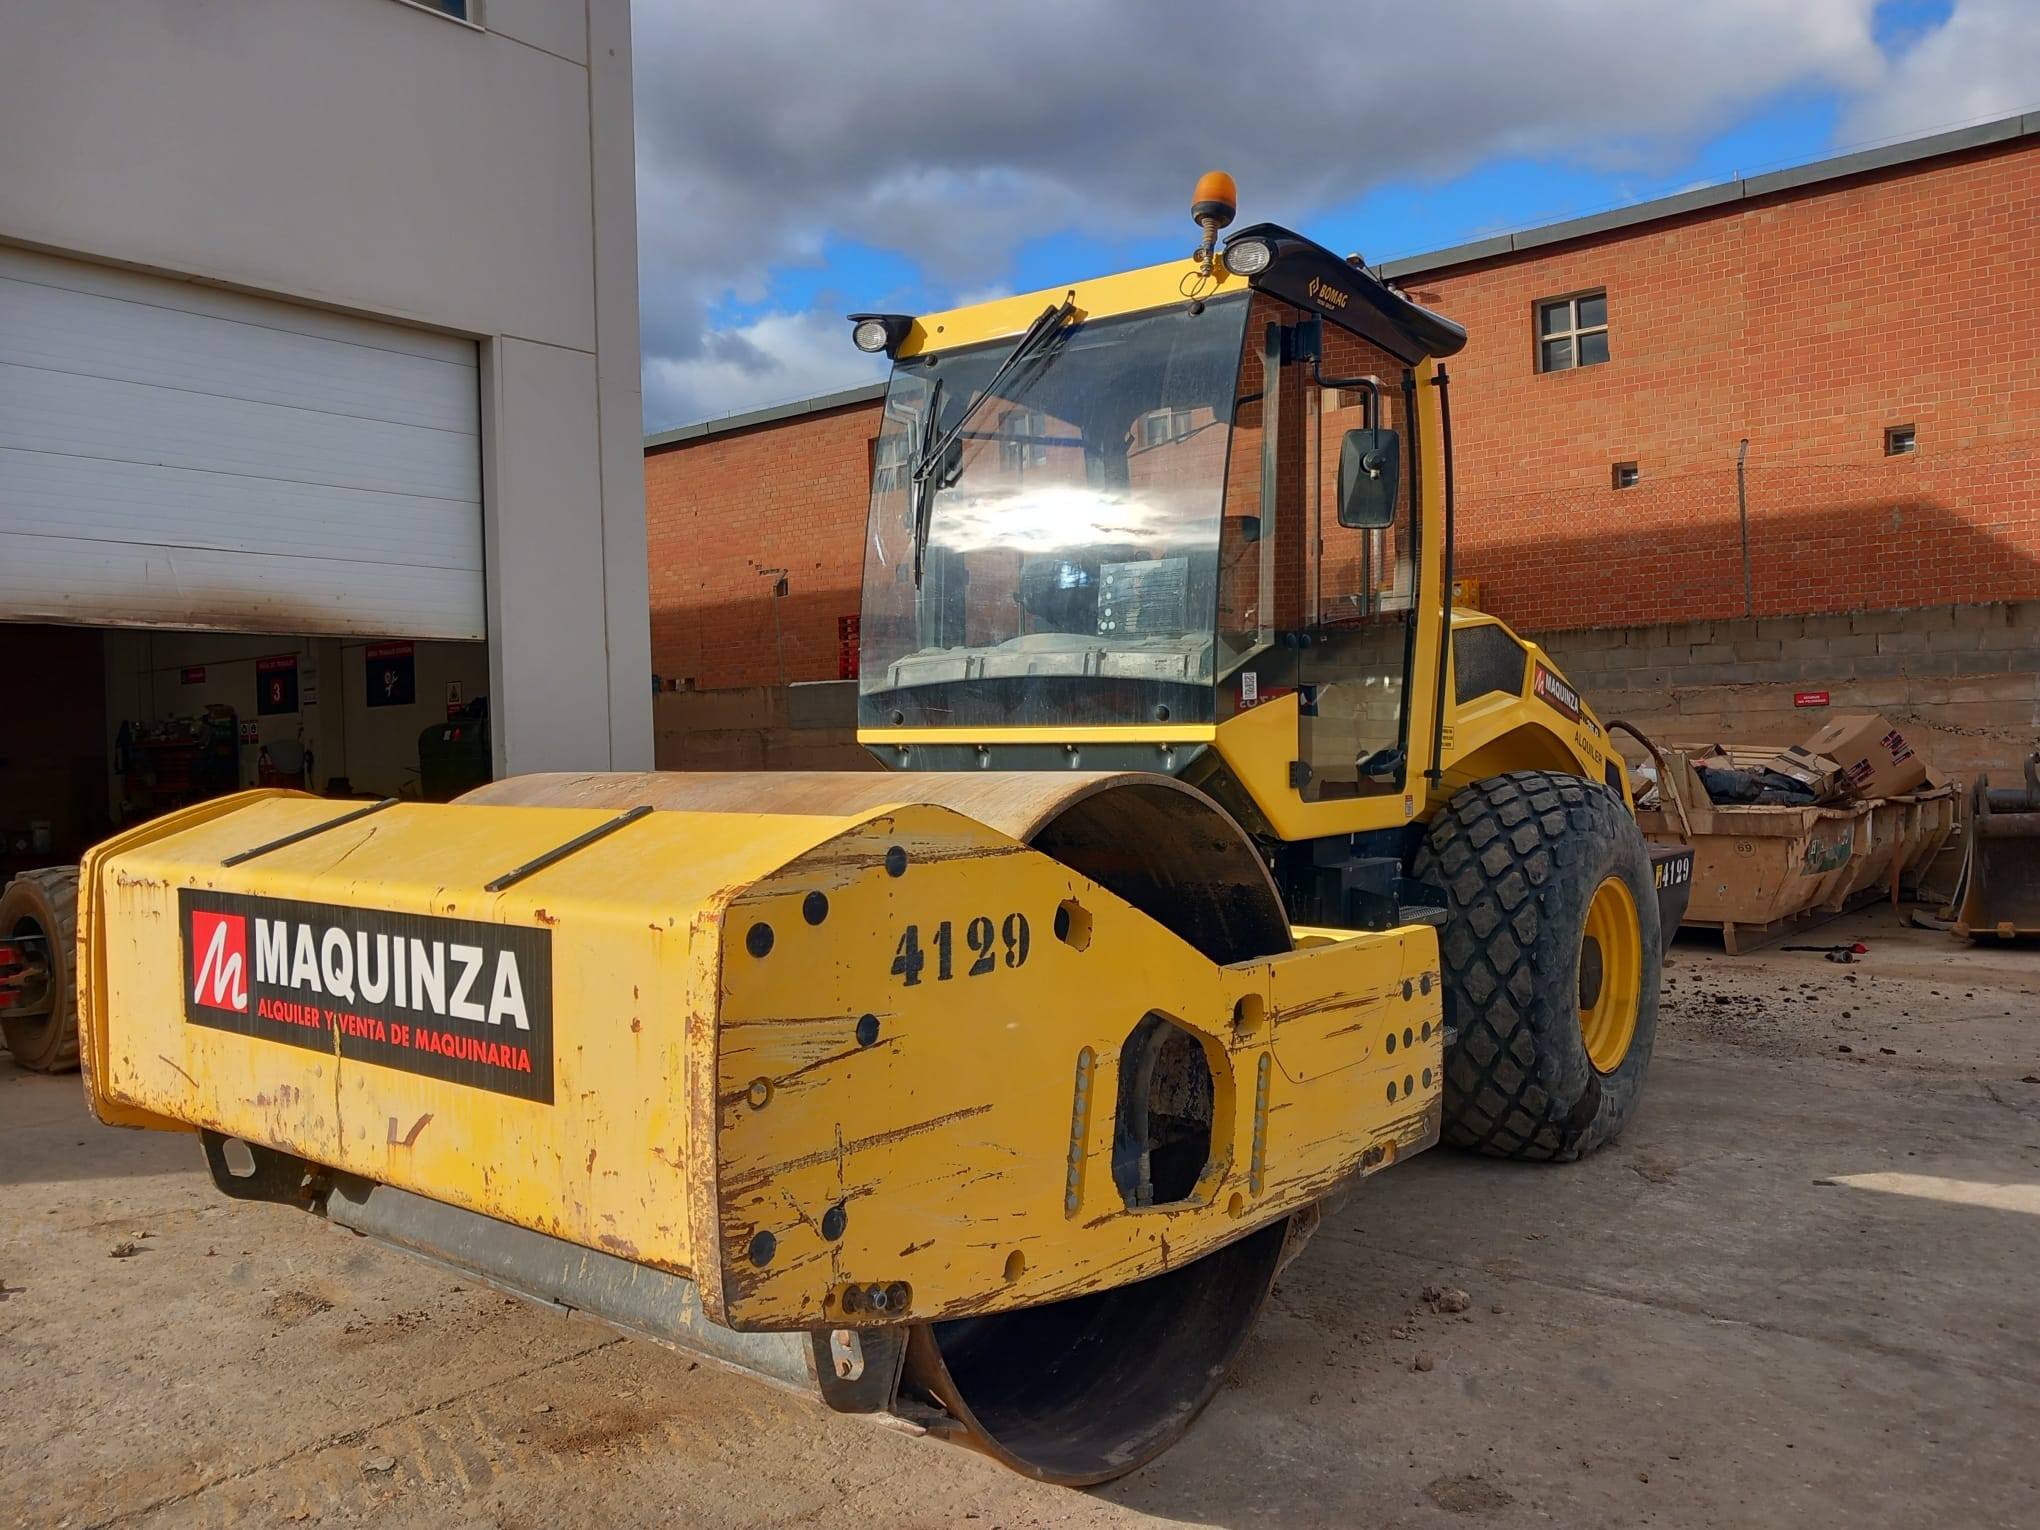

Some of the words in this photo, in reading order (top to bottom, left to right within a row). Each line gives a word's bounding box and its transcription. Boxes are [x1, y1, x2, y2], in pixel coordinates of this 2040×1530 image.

[1319, 285, 1348, 308] BOMAG
[273, 682, 281, 701] 3
[1545, 674, 1579, 714] MAQUINZA
[1575, 730, 1603, 766] ALQUILER
[1662, 857, 1690, 887] 4129
[890, 912, 1030, 987] 4129
[255, 918, 530, 1030] MAQUINZA
[257, 998, 321, 1029] ALQUILER
[323, 1009, 335, 1032] Y
[337, 1011, 386, 1043] VENTA
[390, 1023, 411, 1047] DE
[415, 1028, 532, 1073] MAQUINARIA
